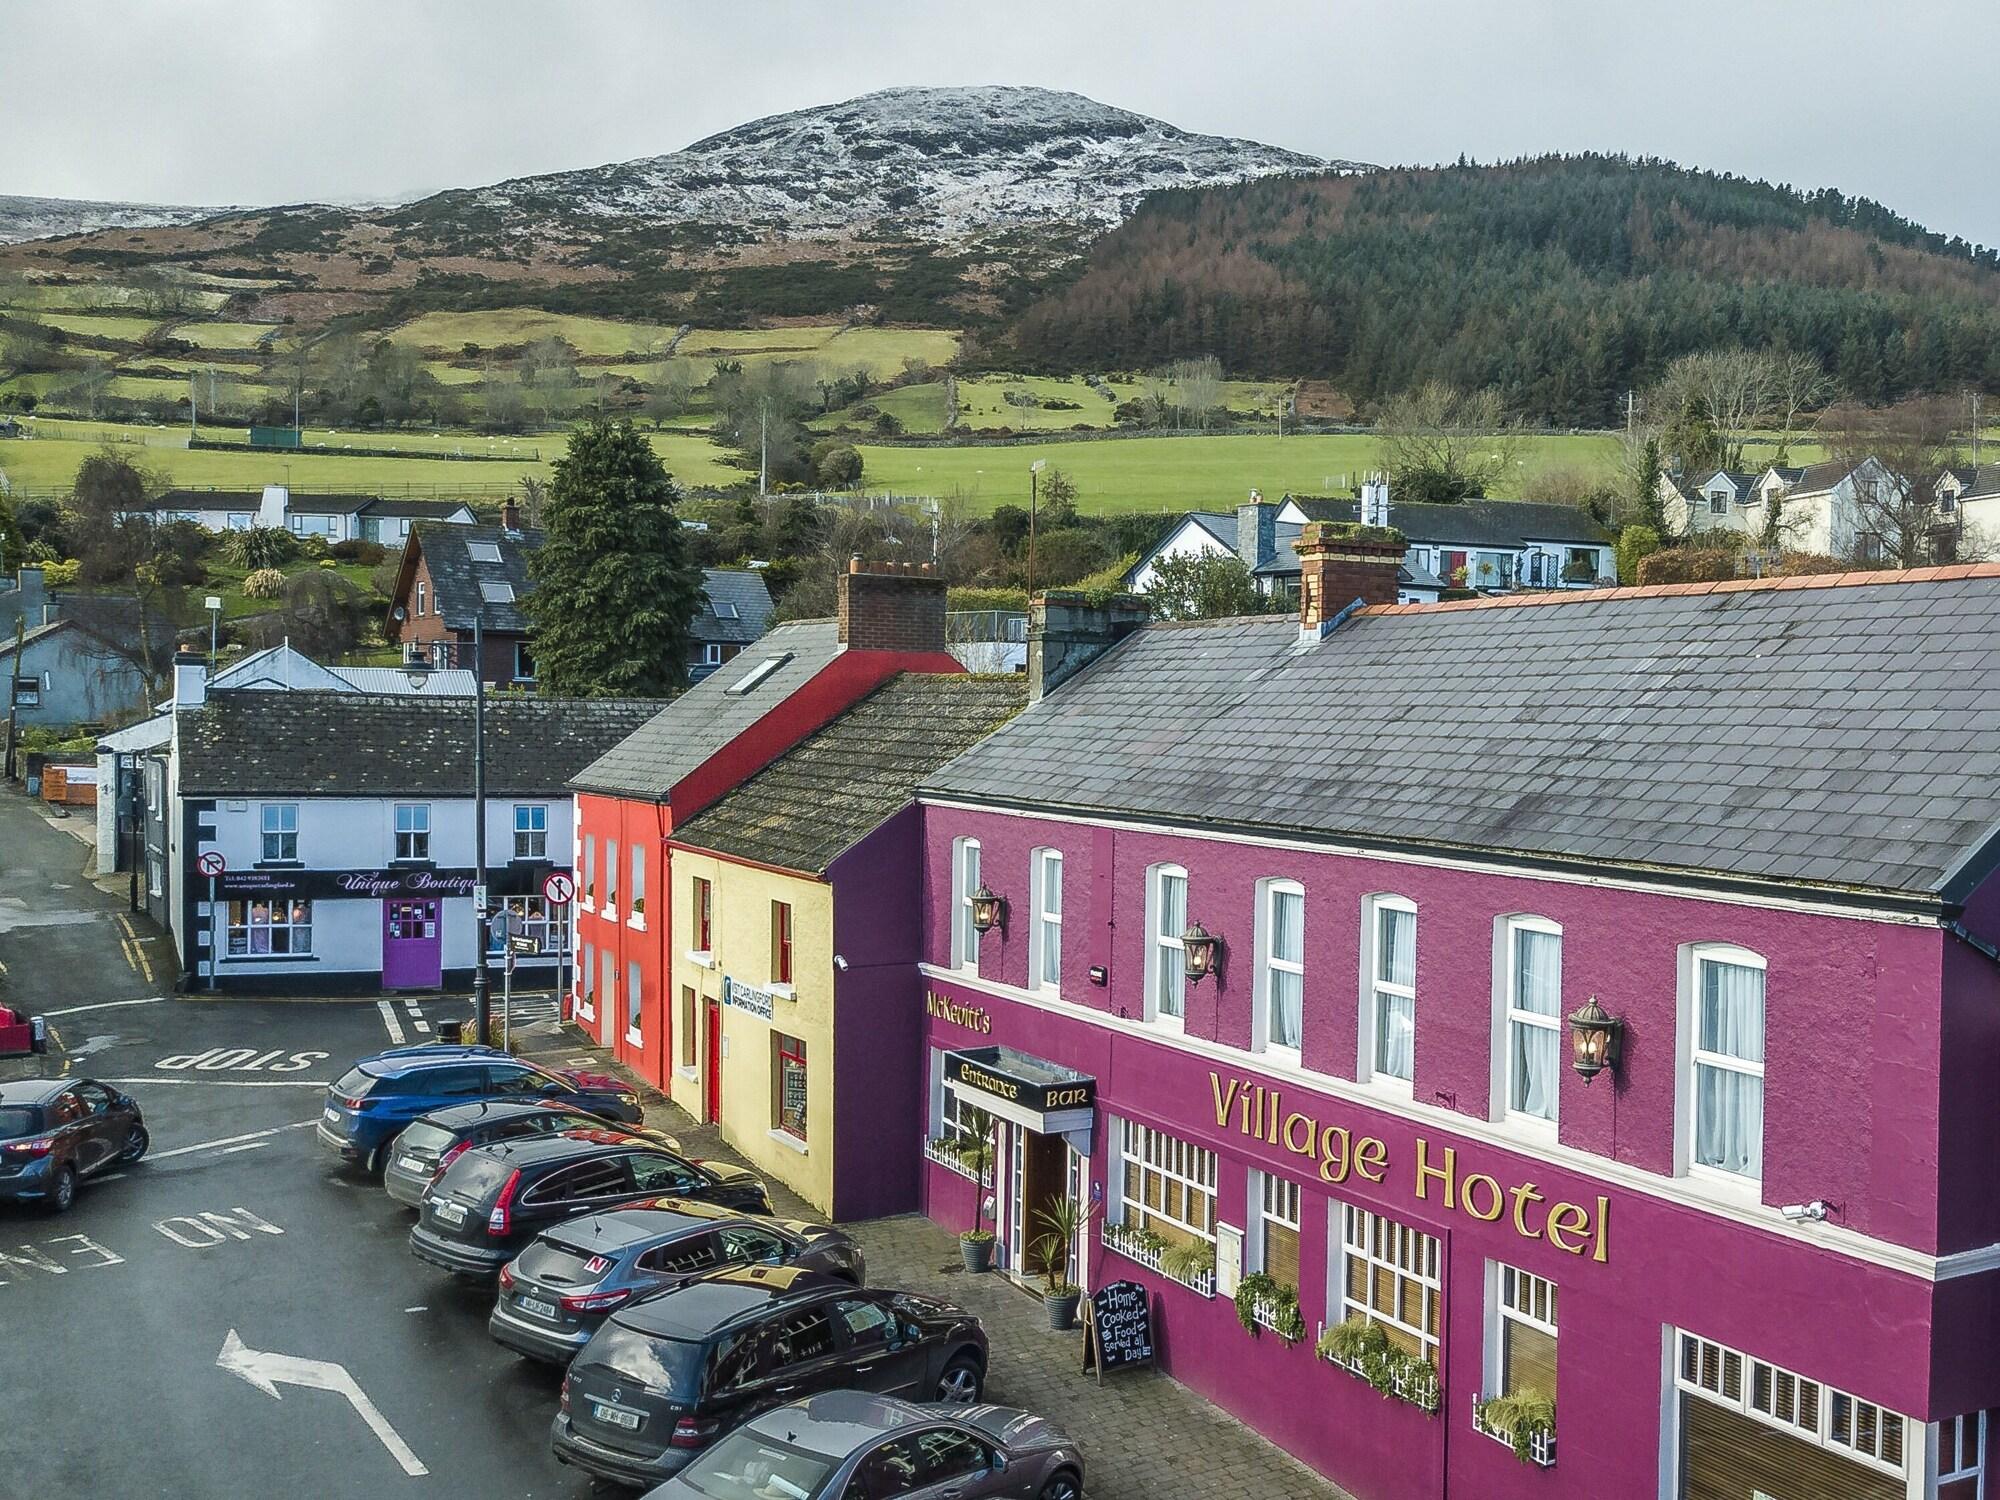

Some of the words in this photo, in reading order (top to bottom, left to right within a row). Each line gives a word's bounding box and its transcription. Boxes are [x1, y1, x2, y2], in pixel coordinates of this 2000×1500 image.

[336, 872, 401, 896] Unique
[406, 871, 480, 895] Boutiqu
[757, 1004, 772, 1020] OFFICE
[927, 990, 992, 1034] McKevitt's
[154, 1047, 330, 1072] STOP
[1208, 1071, 1390, 1185] Village
[1415, 1137, 1612, 1264] Hotel
[152, 1207, 285, 1248] NO
[587, 1256, 605, 1272] N
[1107, 1289, 1138, 1310] Home
[1102, 1303, 1140, 1328] Cooked
[1114, 1321, 1137, 1341] Food
[1134, 1333, 1145, 1347] all
[1125, 1347, 1142, 1361] Day
